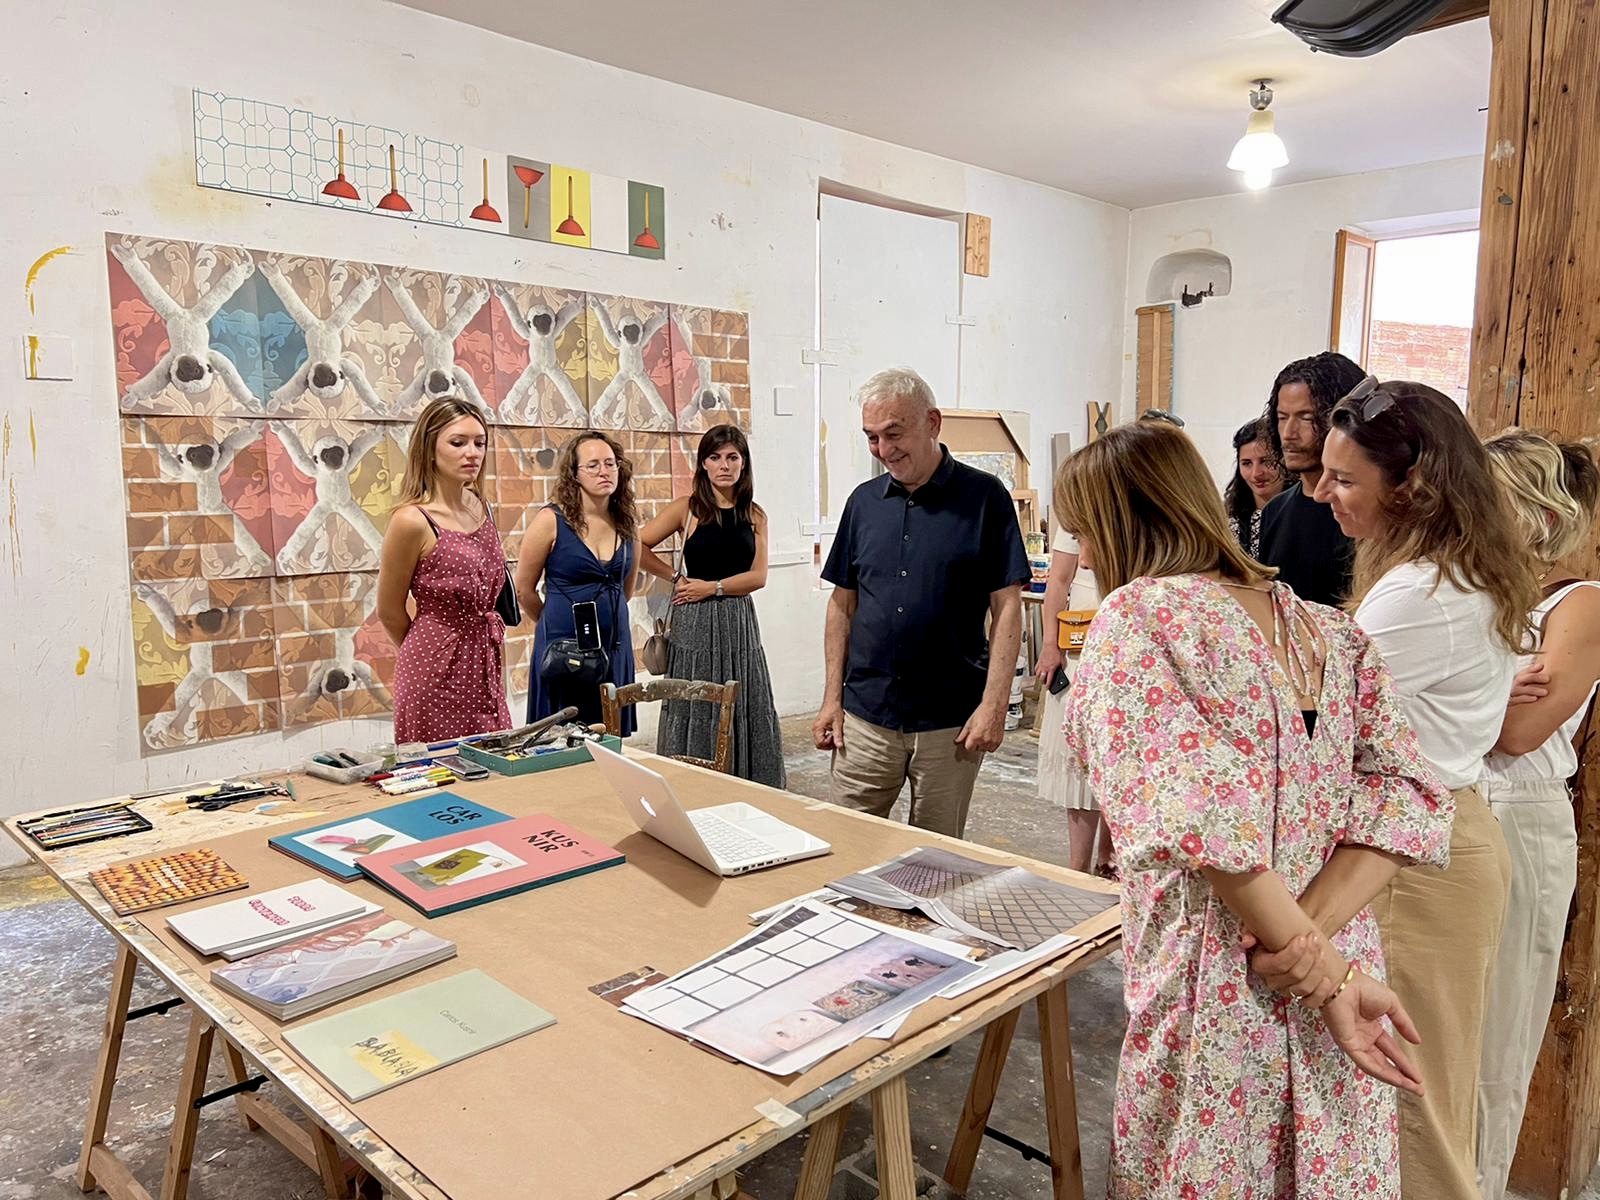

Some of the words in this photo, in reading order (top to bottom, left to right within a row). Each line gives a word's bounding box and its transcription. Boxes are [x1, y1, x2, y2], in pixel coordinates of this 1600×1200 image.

[428, 811, 464, 825] LOS
[447, 805, 482, 820] CAR
[521, 834, 559, 853] NIR
[540, 829, 580, 848] KUS
